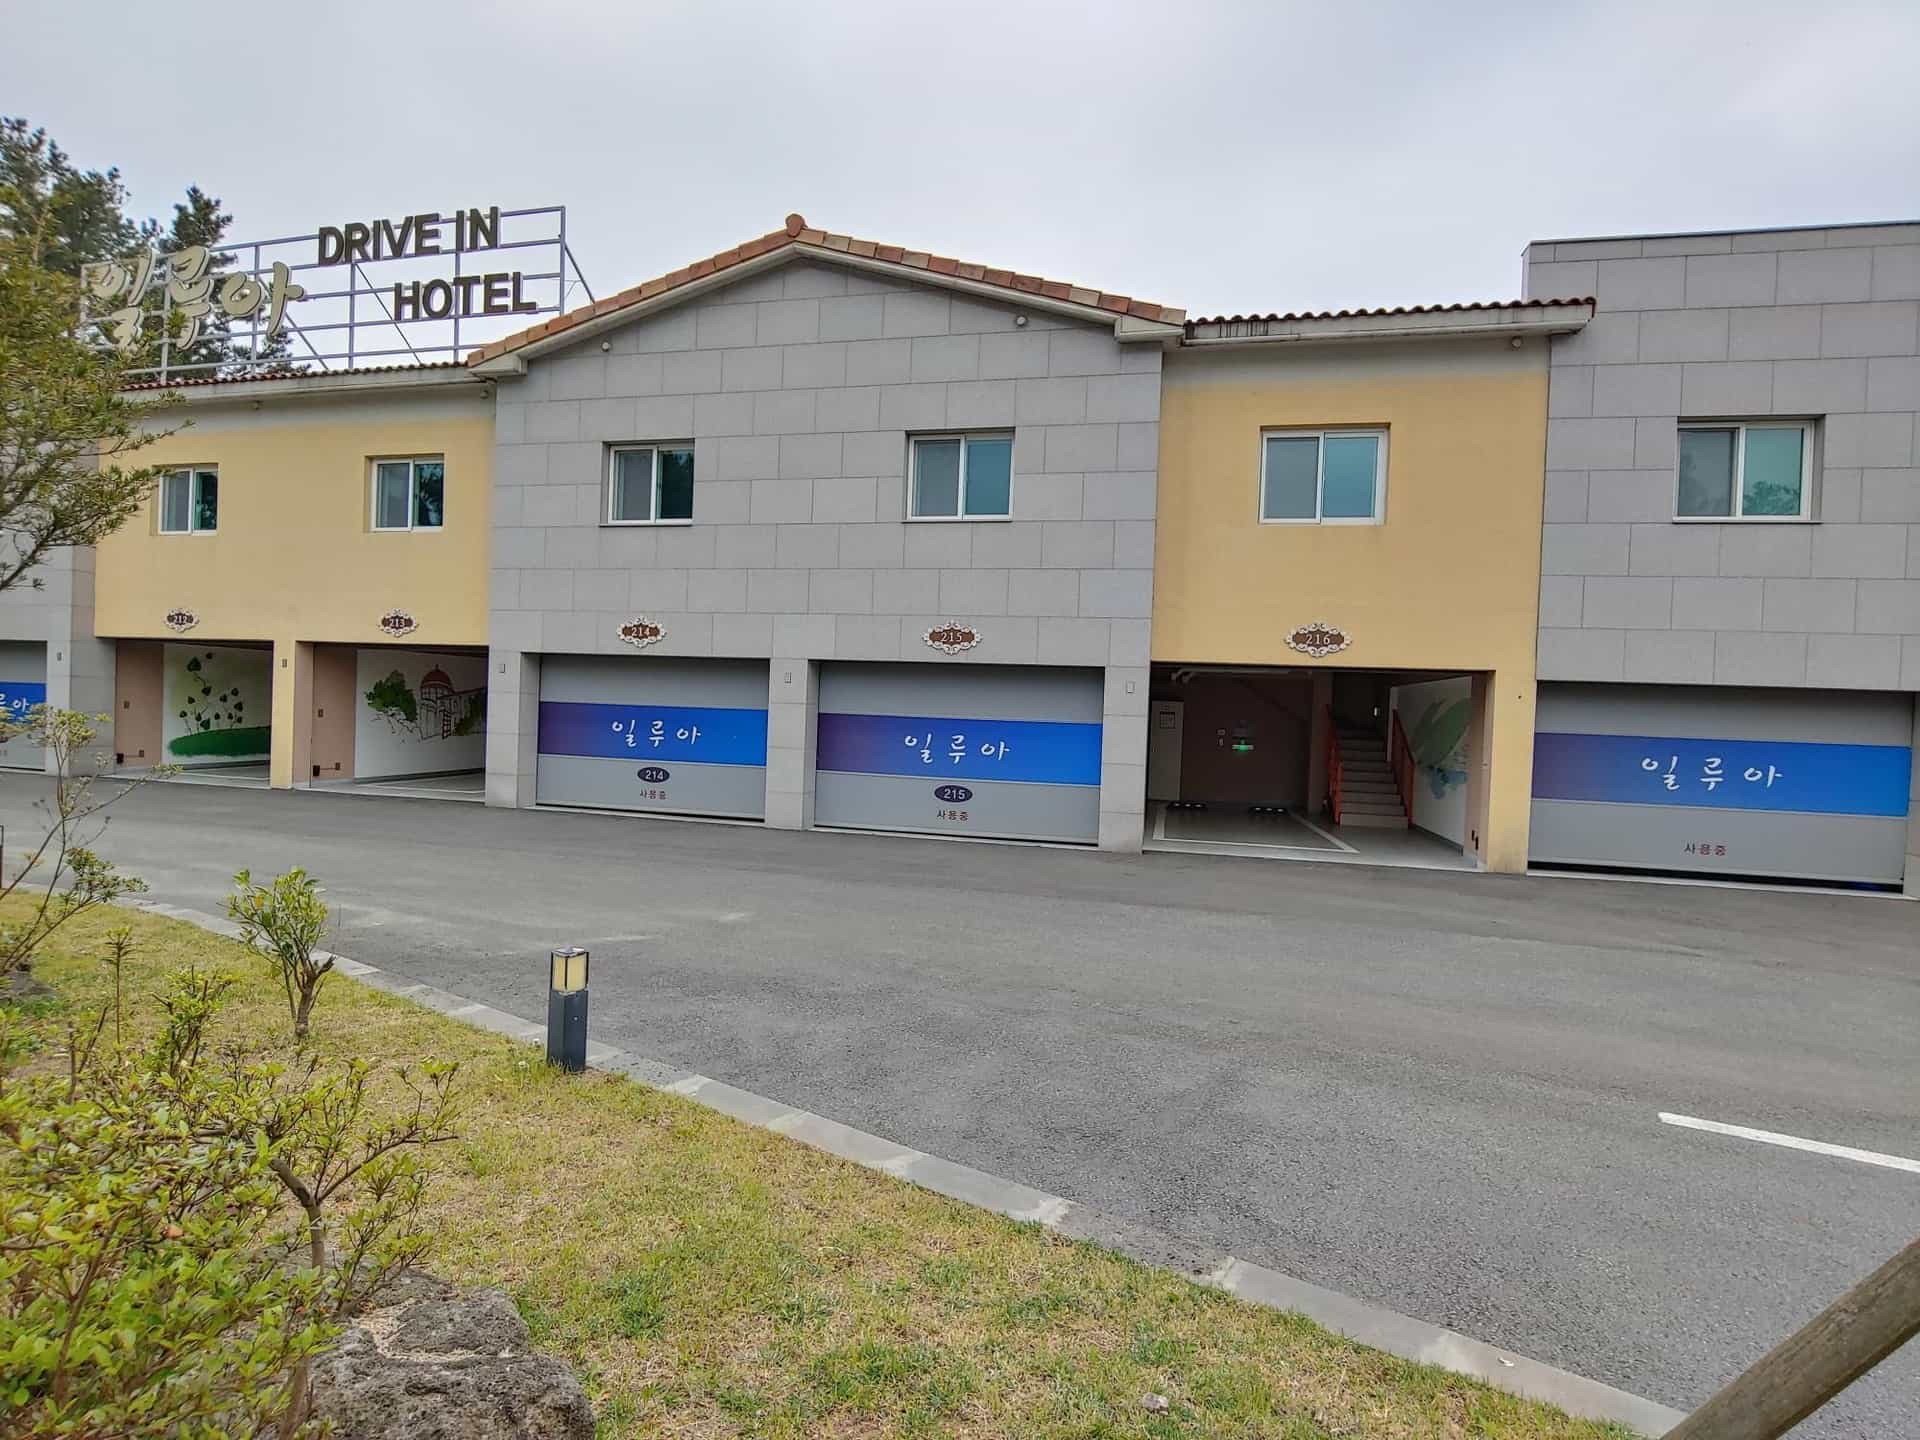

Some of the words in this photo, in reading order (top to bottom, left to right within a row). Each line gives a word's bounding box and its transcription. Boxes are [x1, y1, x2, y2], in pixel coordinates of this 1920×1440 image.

[318, 212, 441, 266] DRIVE
[455, 206, 499, 251] IN
[394, 271, 538, 321] HOTEL
[631, 627, 650, 637] 214
[940, 631, 962, 642] 215
[1306, 633, 1331, 645] 216
[611, 719, 702, 748] 일루아
[904, 733, 1011, 764] 일루아
[645, 769, 664, 781] 214
[1641, 755, 1784, 791] 일루아
[943, 788, 966, 800] 215
[1684, 842, 1727, 857] 사용중
